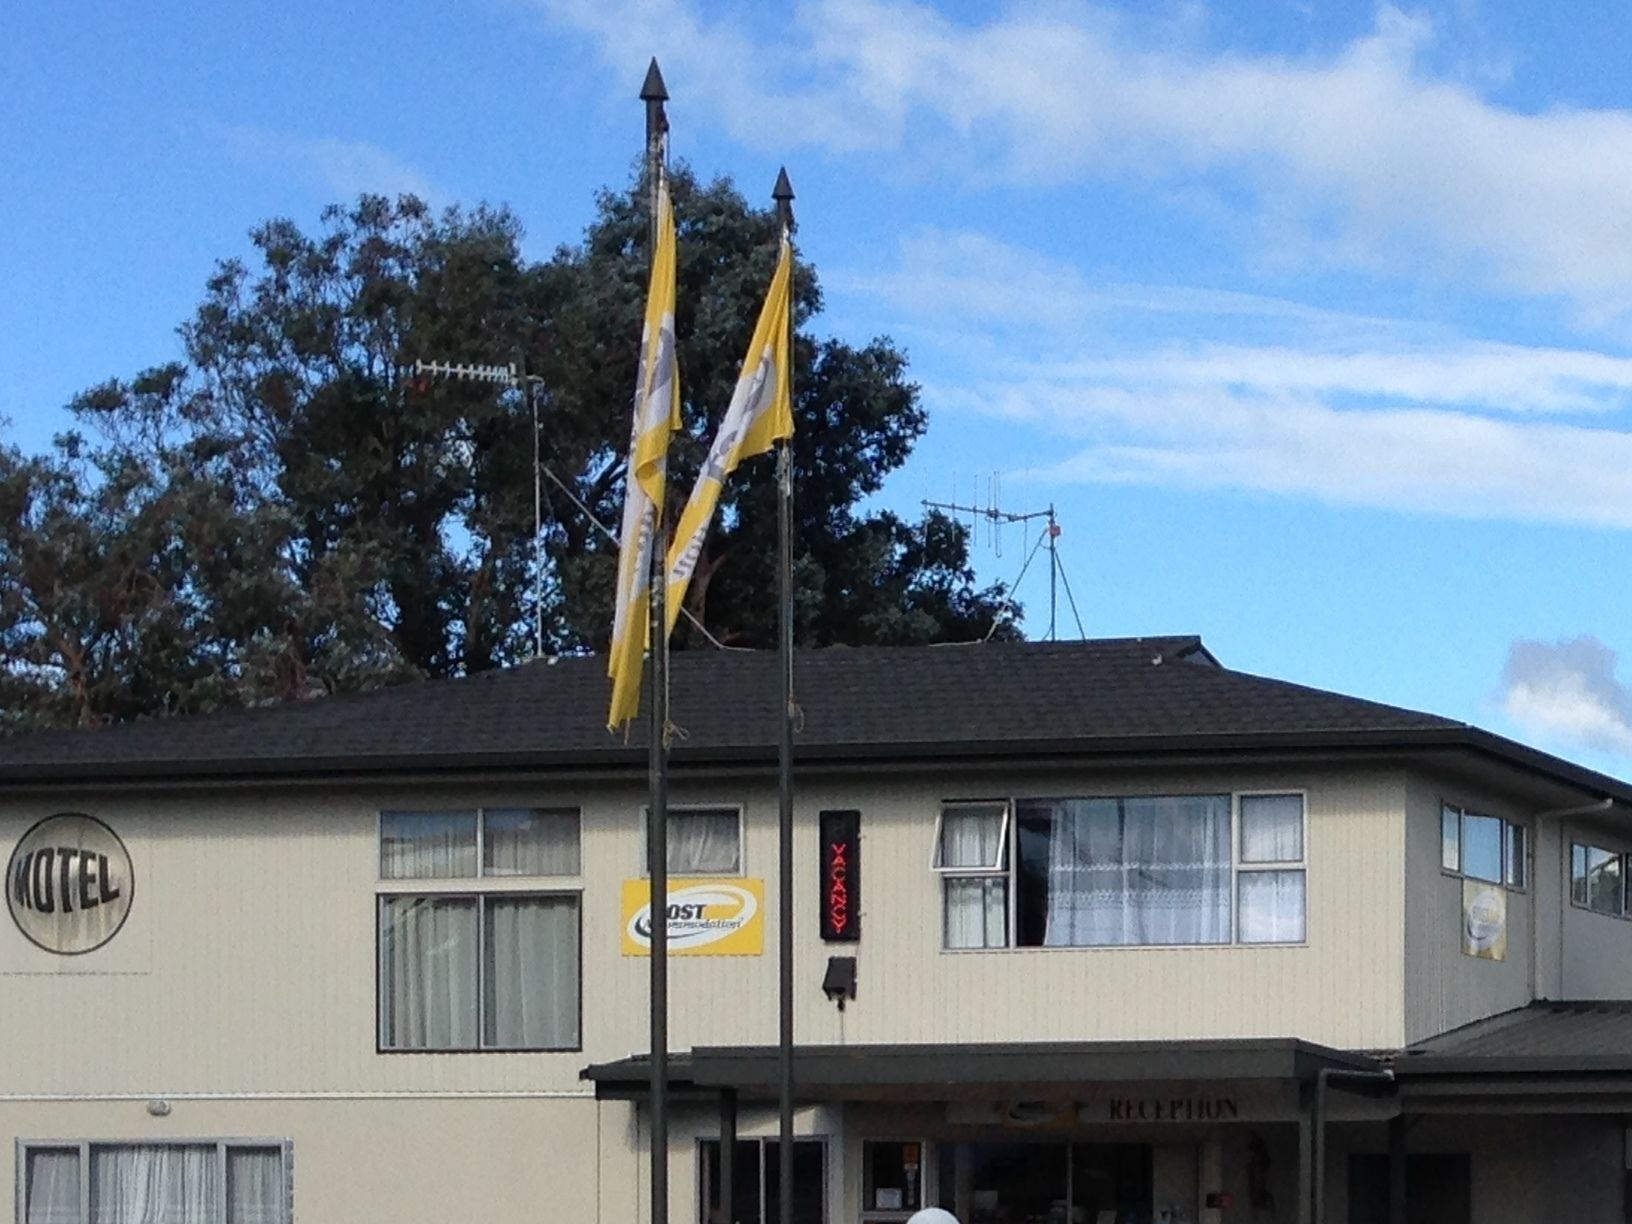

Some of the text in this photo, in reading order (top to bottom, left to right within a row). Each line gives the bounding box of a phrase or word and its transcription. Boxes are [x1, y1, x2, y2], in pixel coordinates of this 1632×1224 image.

[14, 847, 120, 914] MOTEL
[831, 843, 847, 934] VACANCY
[667, 904, 706, 919] OST
[1109, 1098, 1238, 1120] RECEPTION
